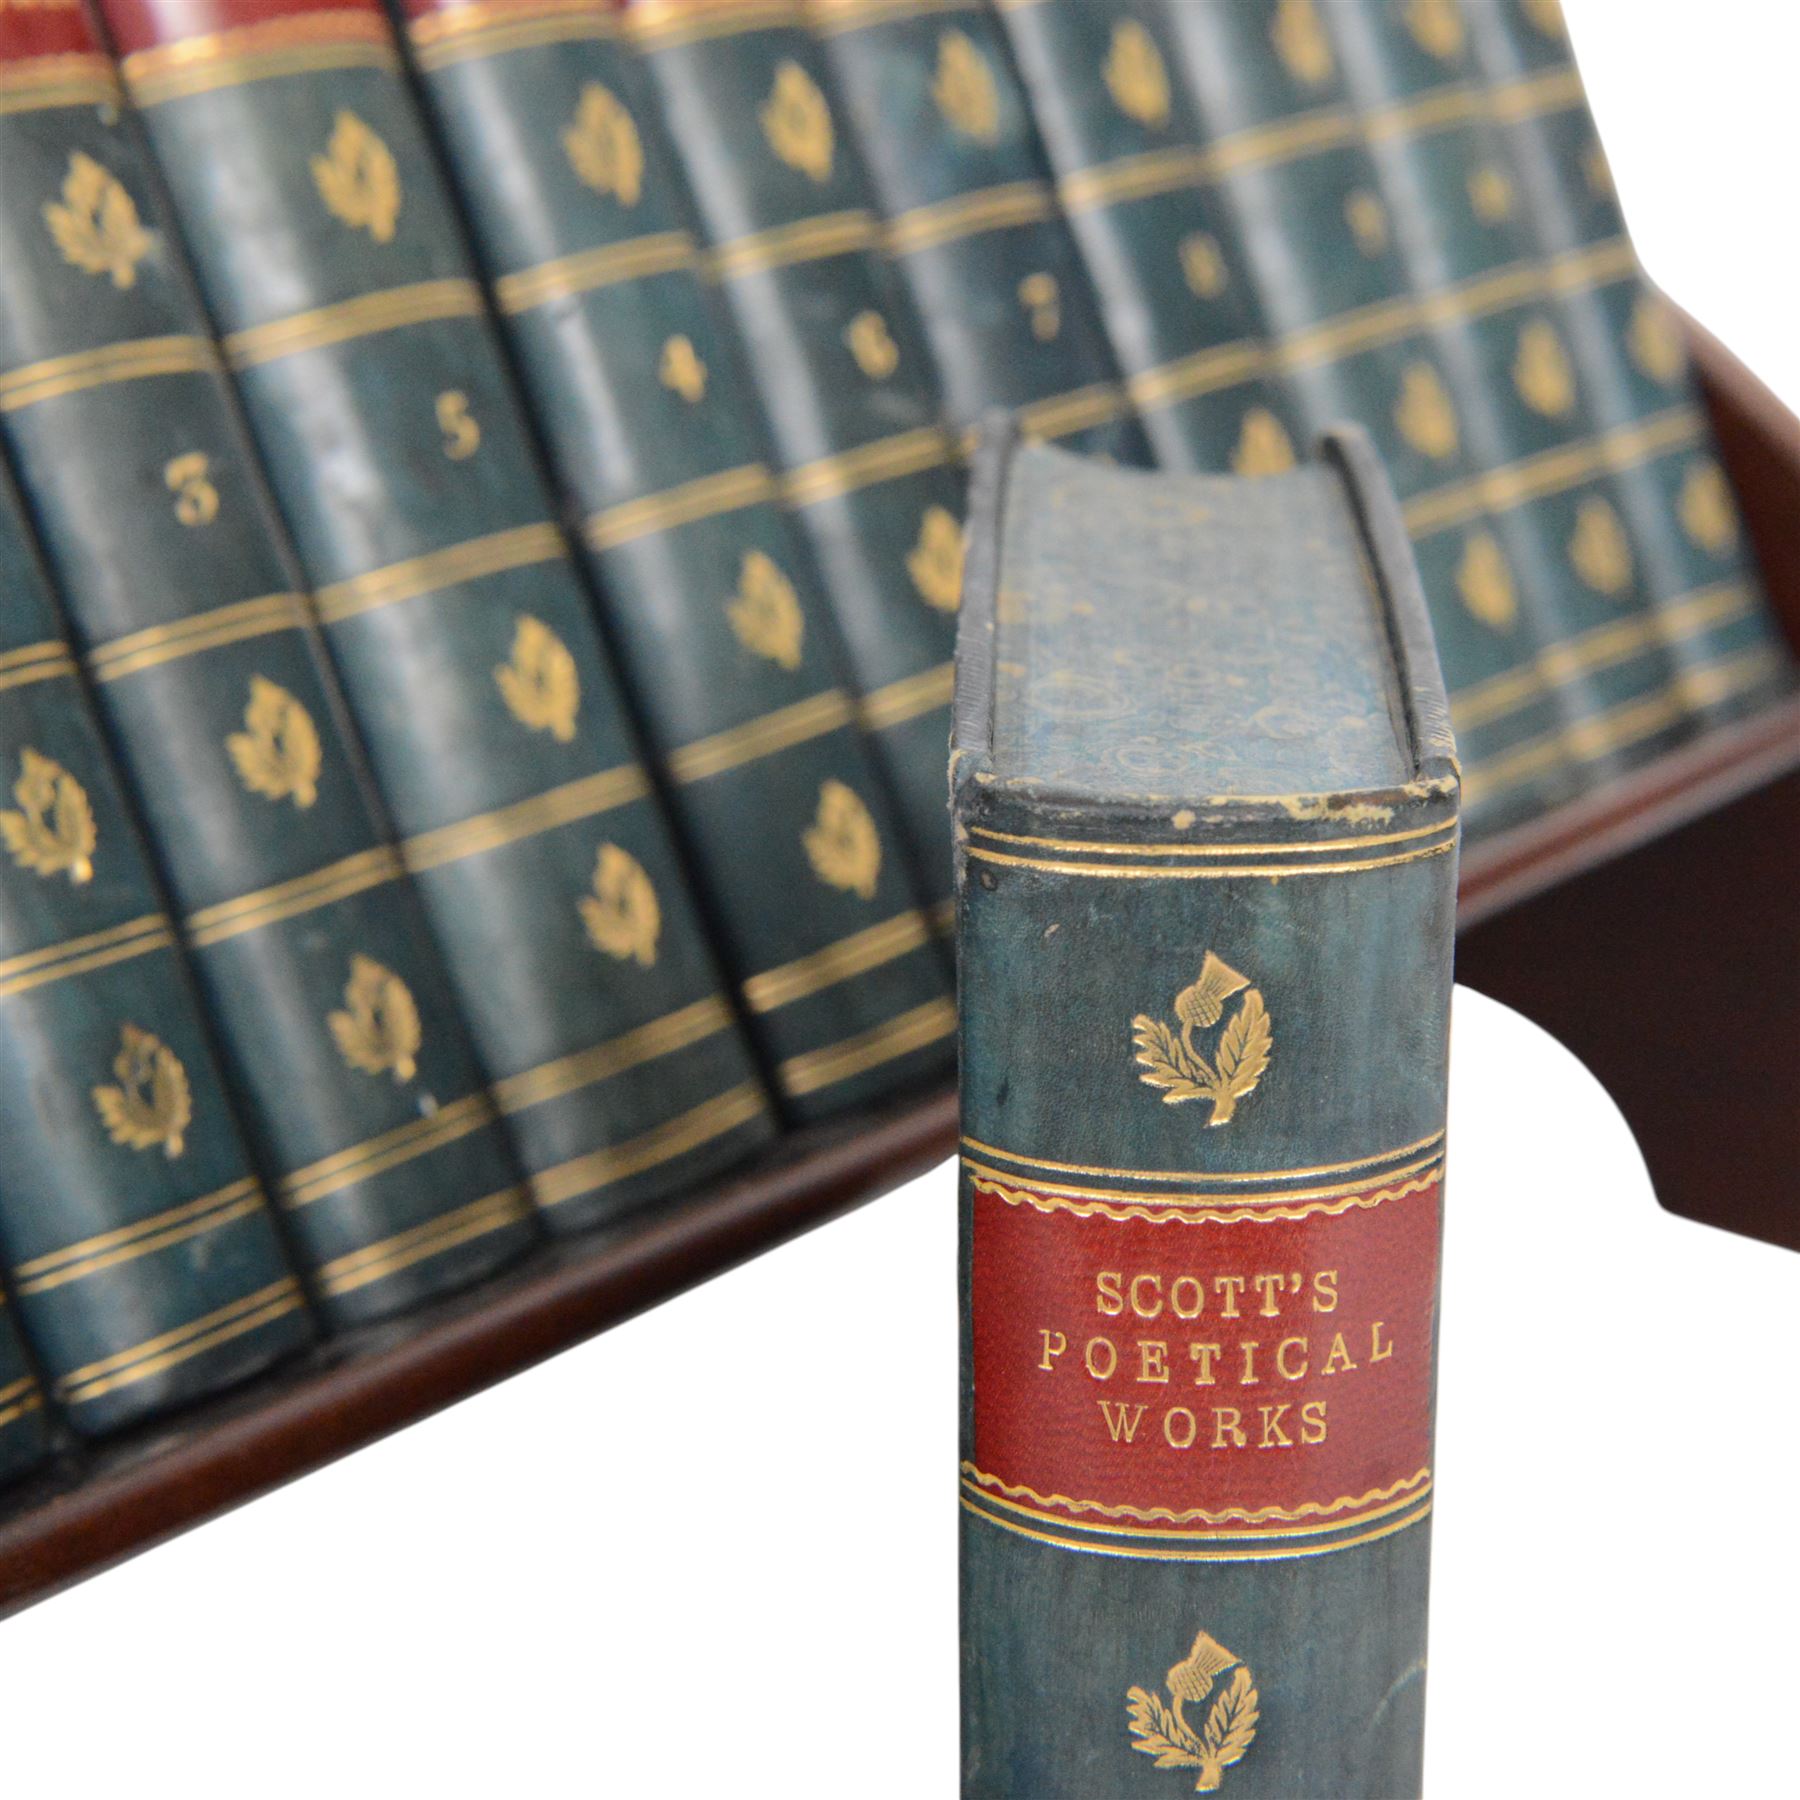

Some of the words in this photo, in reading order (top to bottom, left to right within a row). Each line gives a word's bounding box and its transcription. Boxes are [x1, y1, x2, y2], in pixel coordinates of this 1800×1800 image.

[436, 390, 481, 460] 5
[1096, 1269, 1339, 1320] SCOTT'S
[1038, 1321, 1394, 1386] POETICAL
[1097, 1400, 1328, 1450] WORKS
